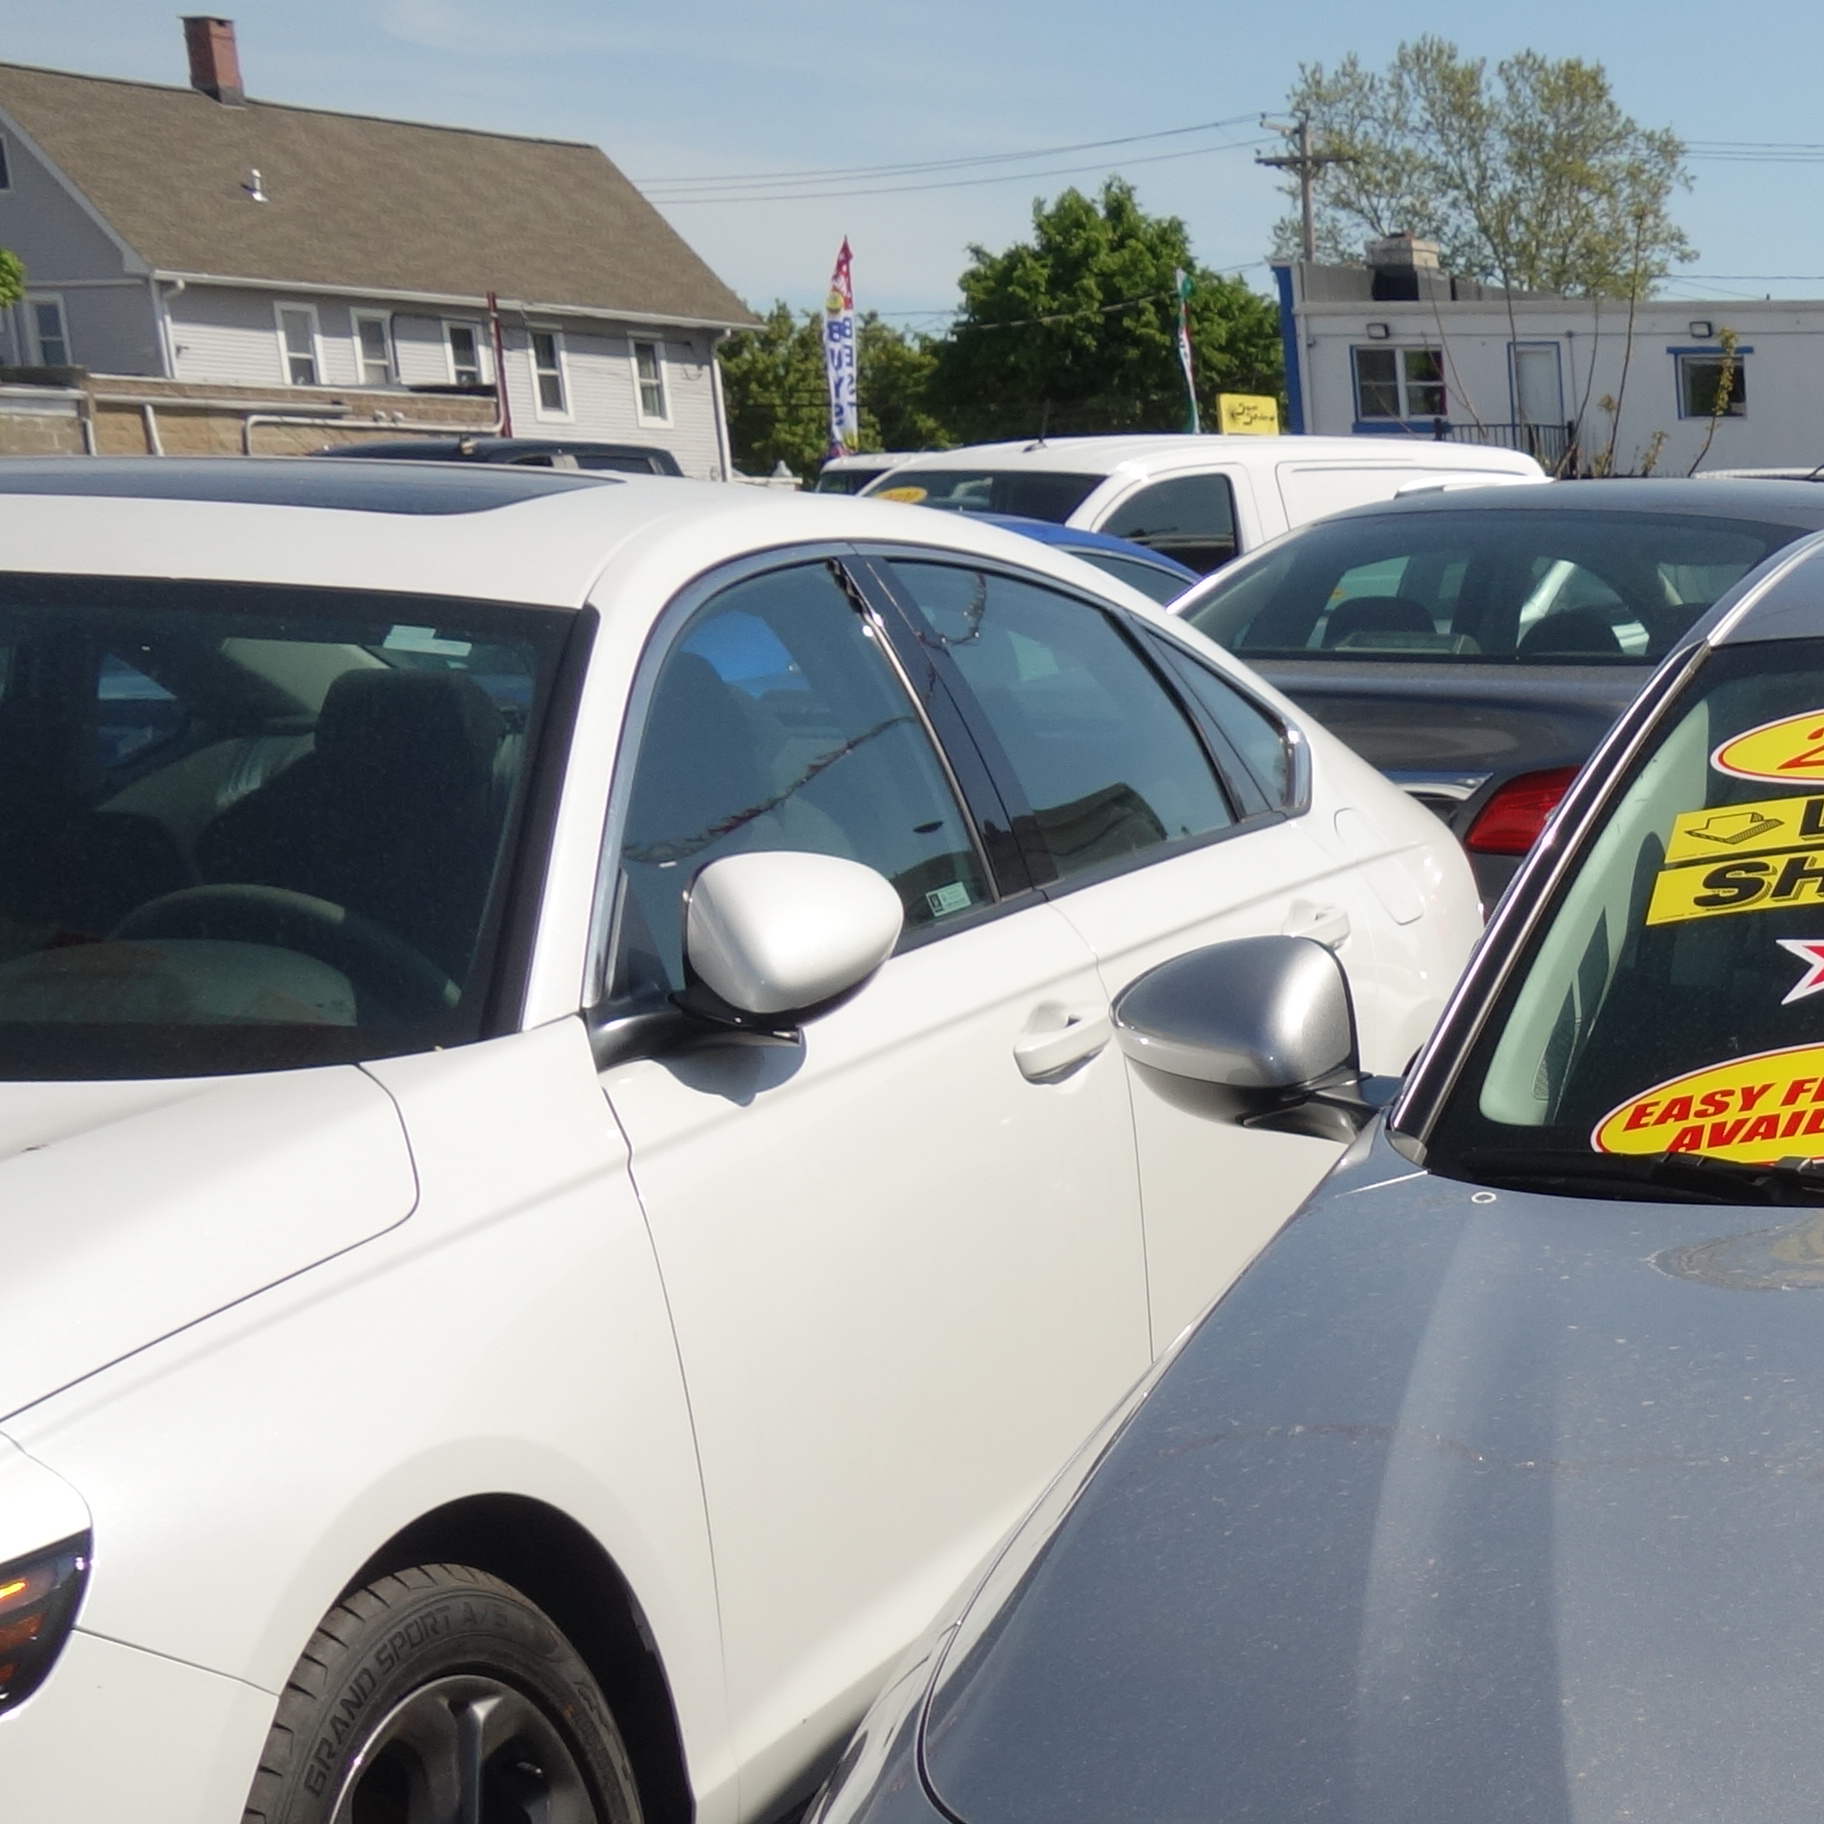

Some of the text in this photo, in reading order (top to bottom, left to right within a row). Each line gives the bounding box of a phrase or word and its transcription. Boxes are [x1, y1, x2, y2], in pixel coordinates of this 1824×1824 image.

[1622, 1083, 1780, 1132] EASY
[304, 1666, 378, 1798] GRAND
[376, 1606, 451, 1675] SPORT
